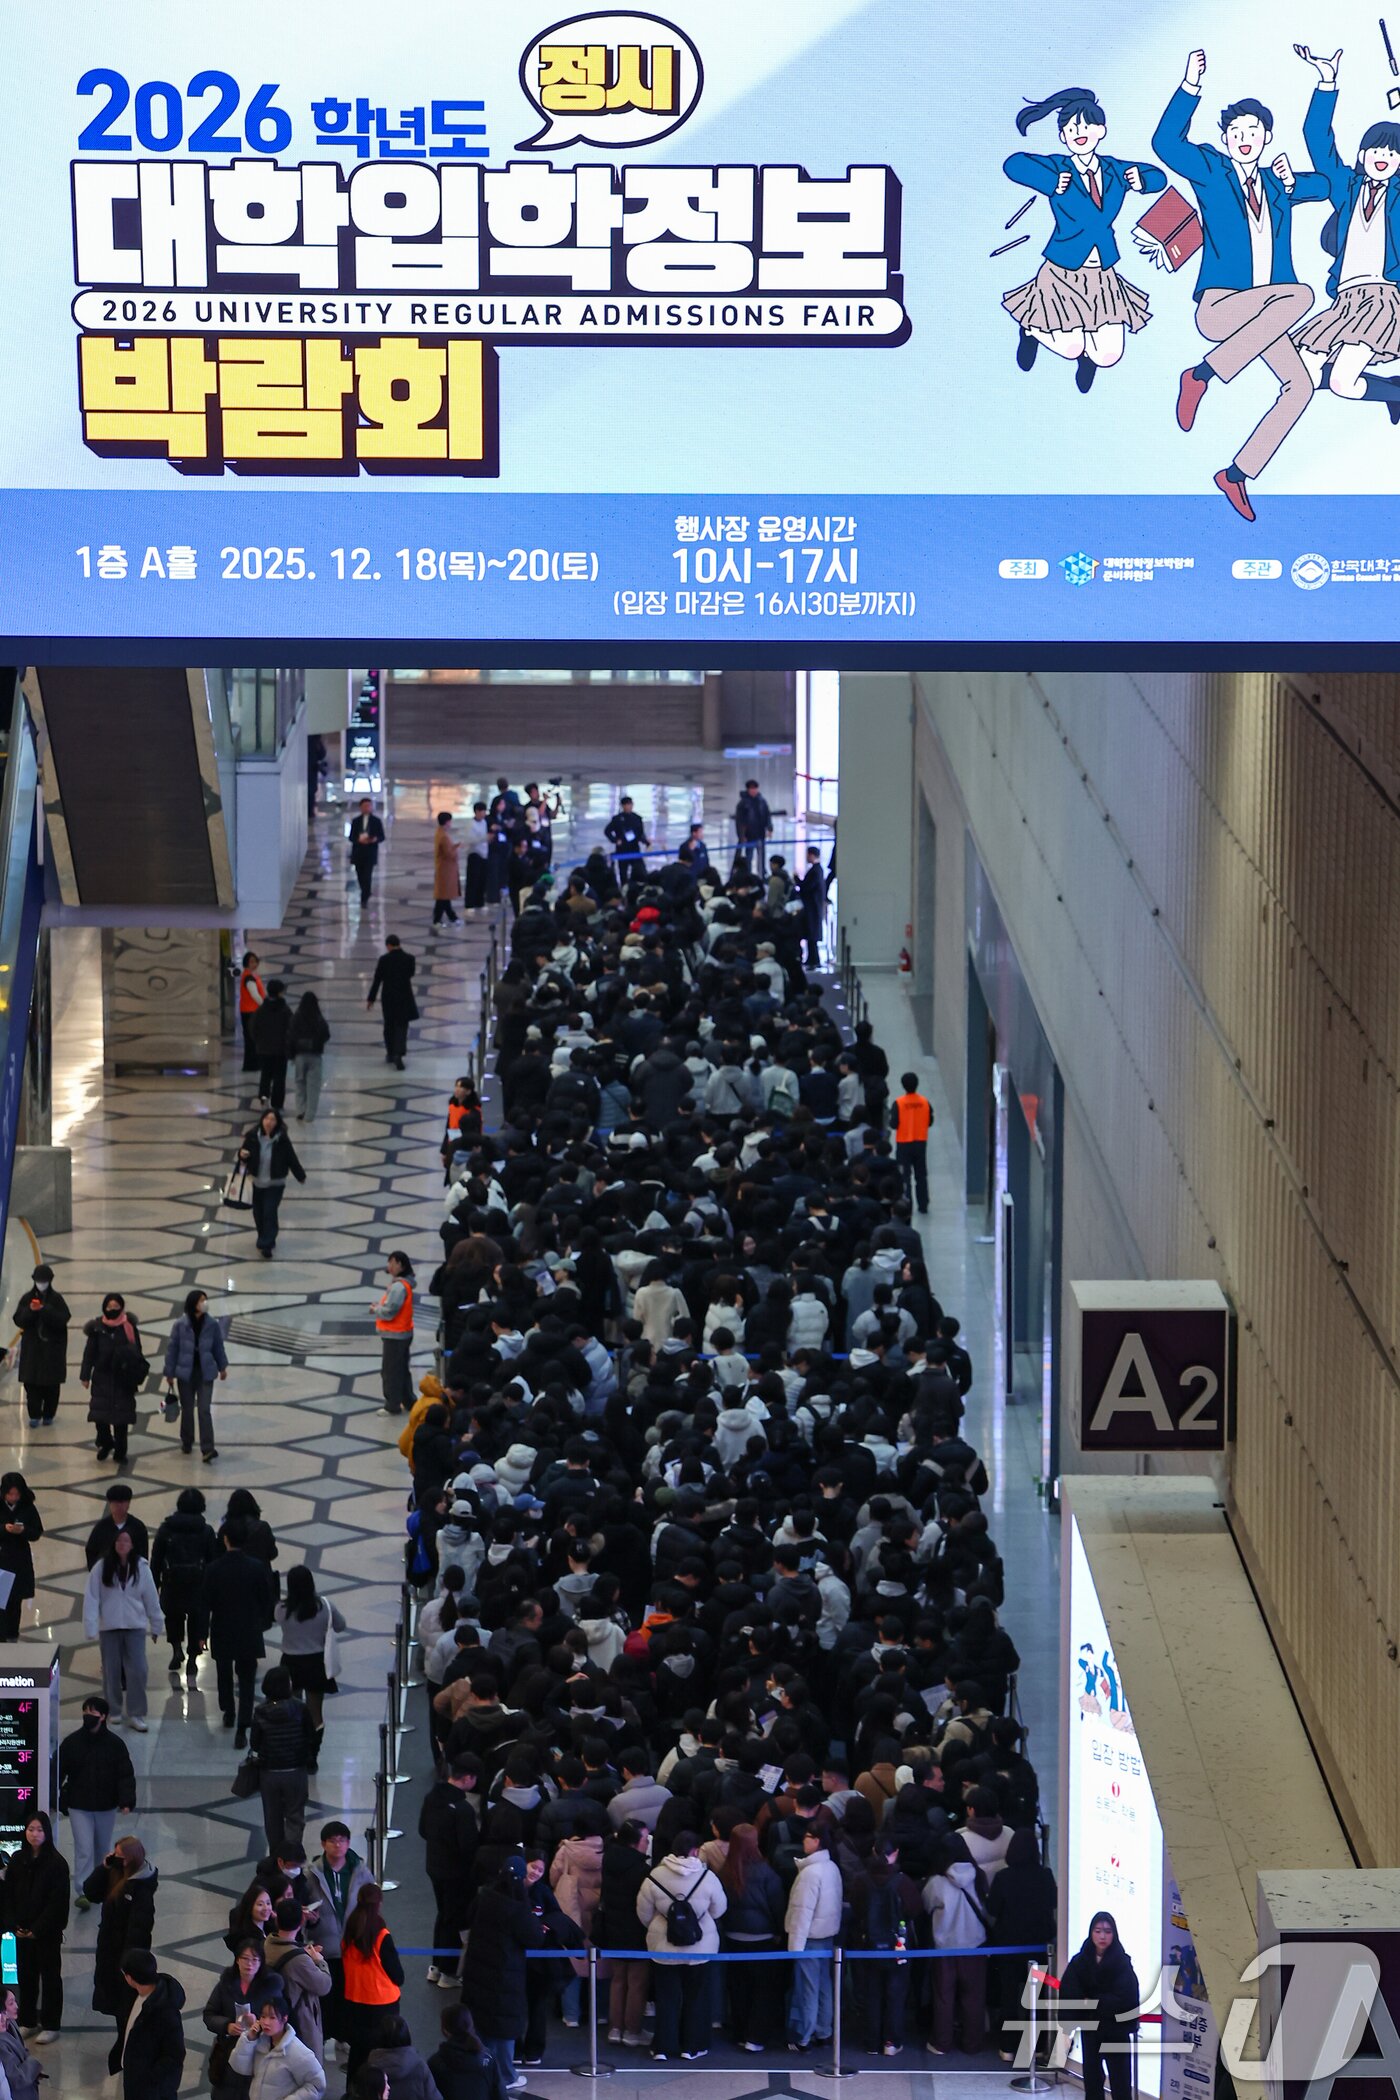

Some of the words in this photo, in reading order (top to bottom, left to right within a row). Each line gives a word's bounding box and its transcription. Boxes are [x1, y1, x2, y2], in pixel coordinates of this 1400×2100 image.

[538, 45, 681, 114] 정시
[76, 68, 293, 154] 2026
[311, 97, 490, 159] 학년도
[73, 160, 889, 292] 대학입학정보
[103, 299, 177, 322] 2026
[195, 301, 392, 324] UNIVERSITY
[411, 303, 562, 325] REGULAR
[579, 304, 785, 326] ADMISSIONS
[803, 305, 875, 327] FAIR
[80, 336, 484, 461] 박람회
[674, 515, 750, 542] 행사장
[757, 515, 857, 542] 운영시간
[76, 545, 128, 579] 1층
[140, 545, 198, 580] A홀
[220, 546, 316, 580] 2025.
[330, 547, 382, 581] 12.
[395, 547, 599, 582] 18(목)~20(토)
[672, 547, 858, 584] 10시-17시
[1009, 561, 1037, 576] 주최
[1243, 561, 1271, 577] 주관
[613, 590, 669, 616] (입장
[675, 591, 745, 616] 마감은
[755, 591, 917, 617] 16시30분까지)
[1090, 1332, 1219, 1431] A2
[18, 1702, 32, 1713] 4F
[17, 1751, 32, 1763] 3F
[17, 1788, 32, 1800] 2F
